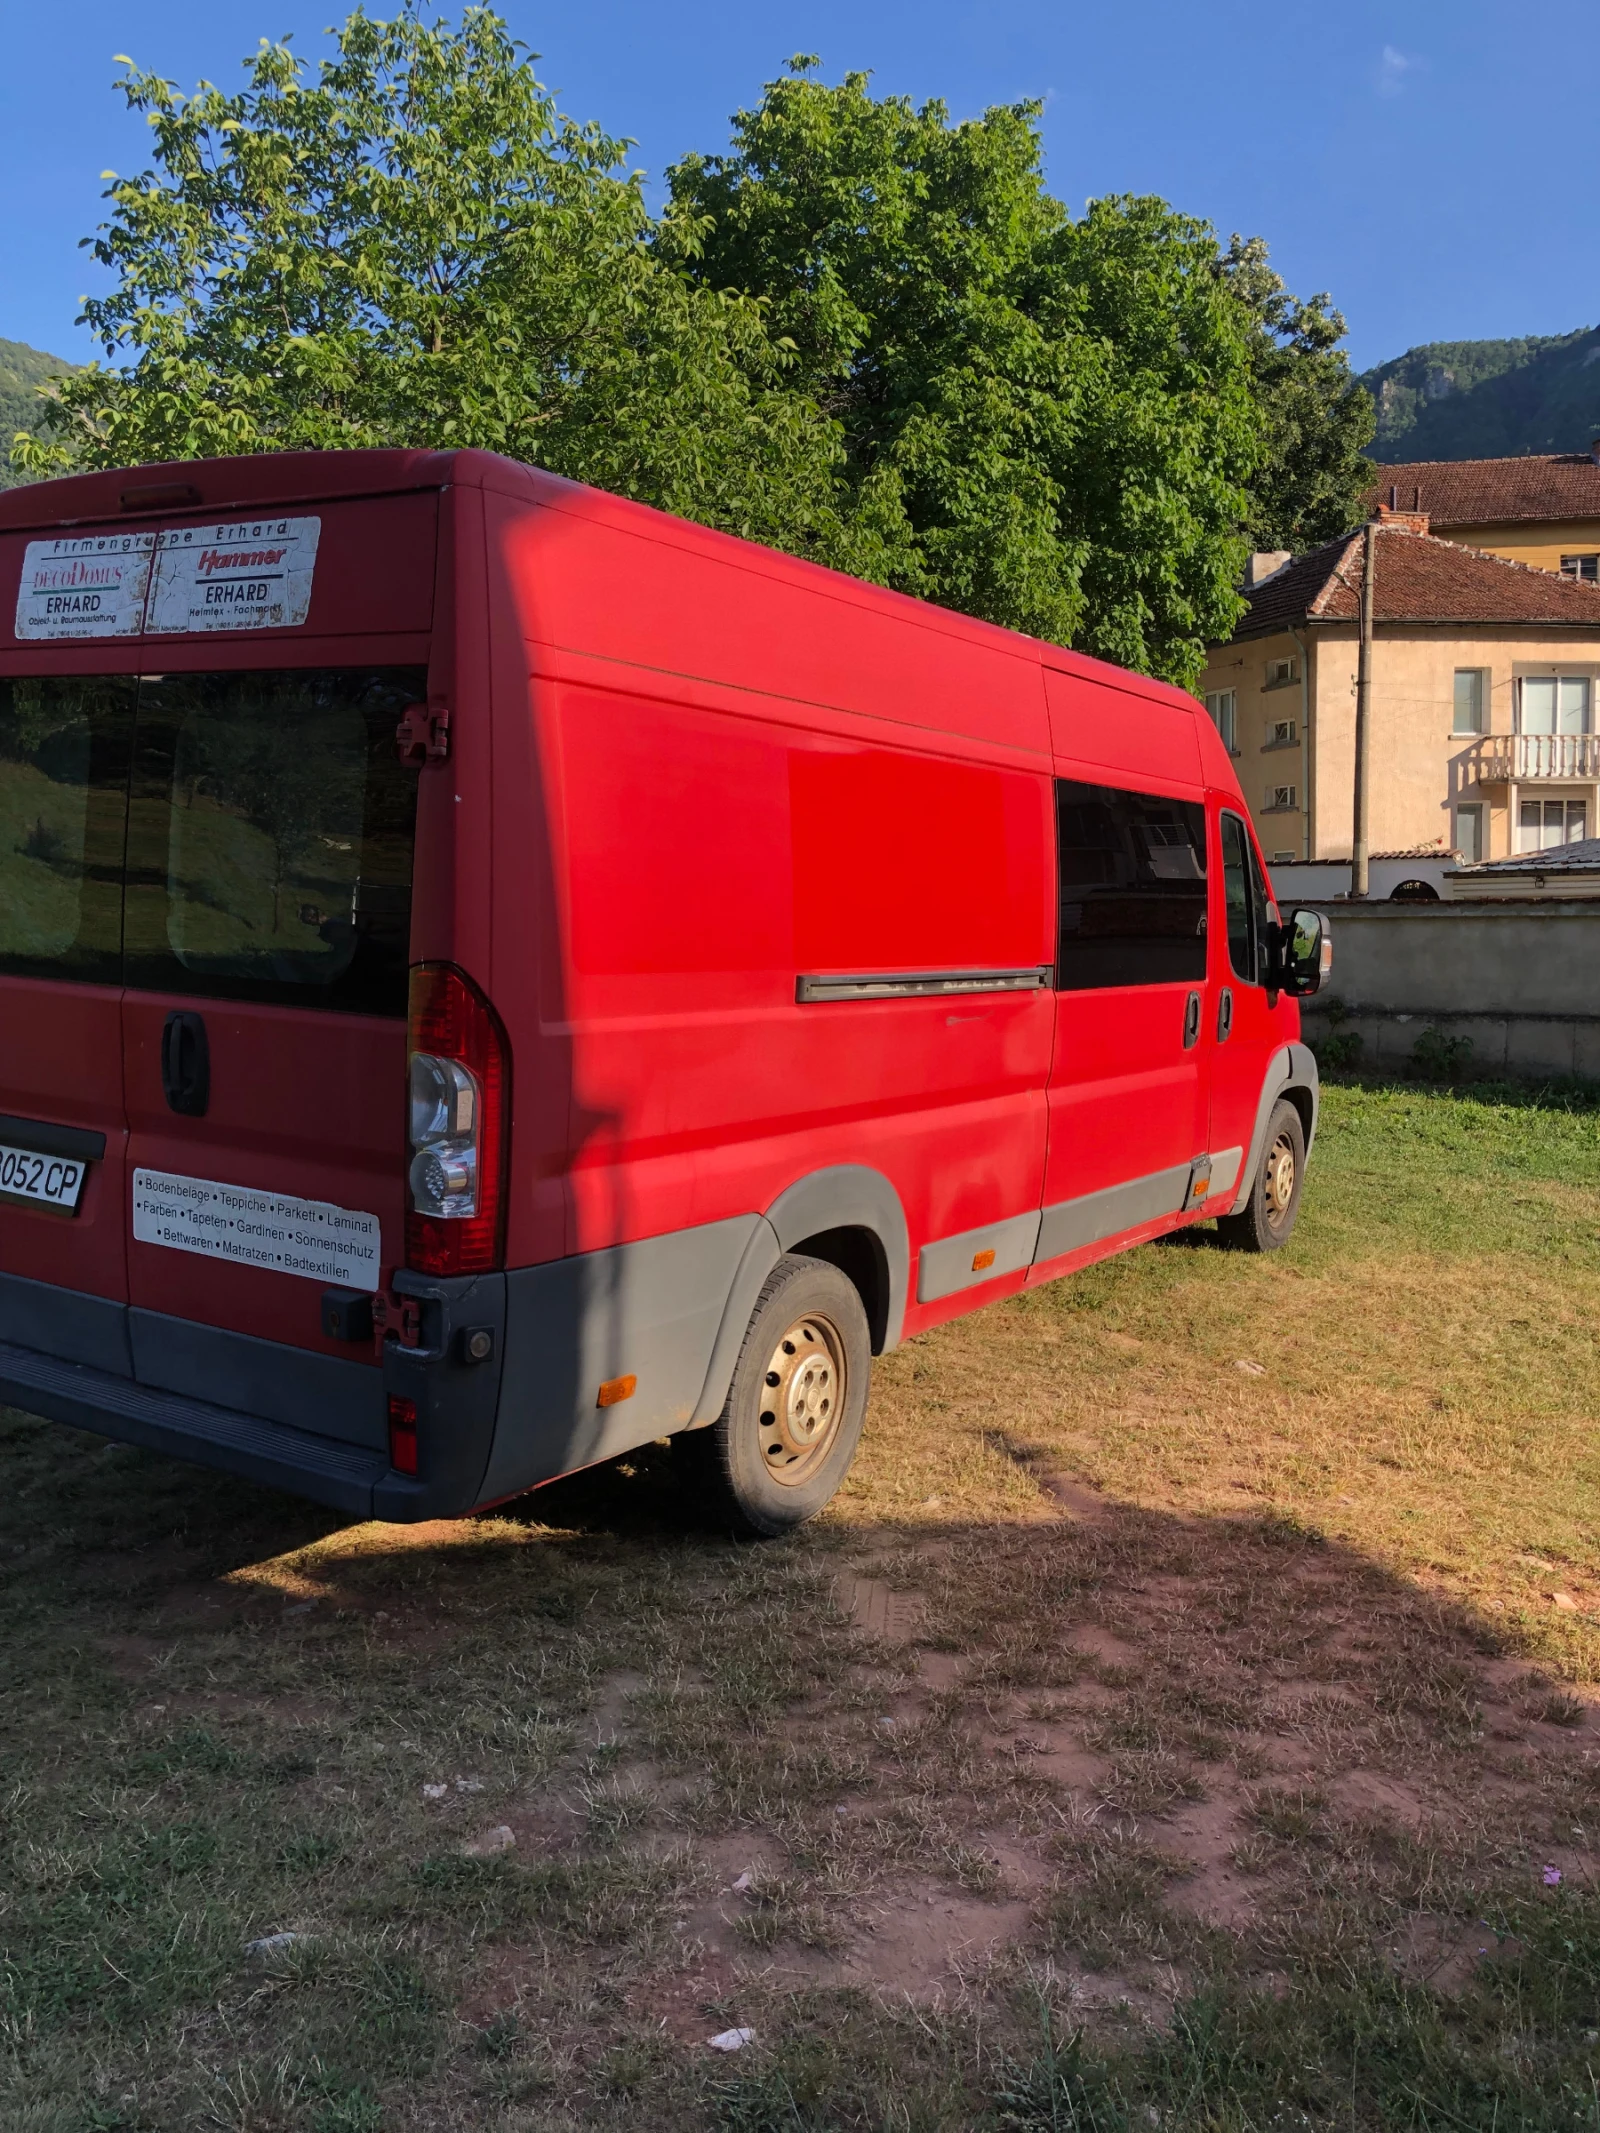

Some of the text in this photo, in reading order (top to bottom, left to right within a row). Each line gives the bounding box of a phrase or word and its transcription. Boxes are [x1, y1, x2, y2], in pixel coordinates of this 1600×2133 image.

[53, 521, 287, 553] Firmengruppe Erhard
[198, 549, 287, 575] Hammer
[46, 595, 101, 614] ERHARD
[206, 584, 268, 604] ERHARD
[189, 607, 224, 617] Heimtex
[0, 1151, 44, 1193] 052
[145, 1178, 373, 1233] Bodenbeläge Teppiche Parkett Laminat
[143, 1201, 374, 1259] Farben Tapeten Gardinen Sonnenschutz
[164, 1228, 350, 1279] Bettwaren Matratzen Badtextilien
